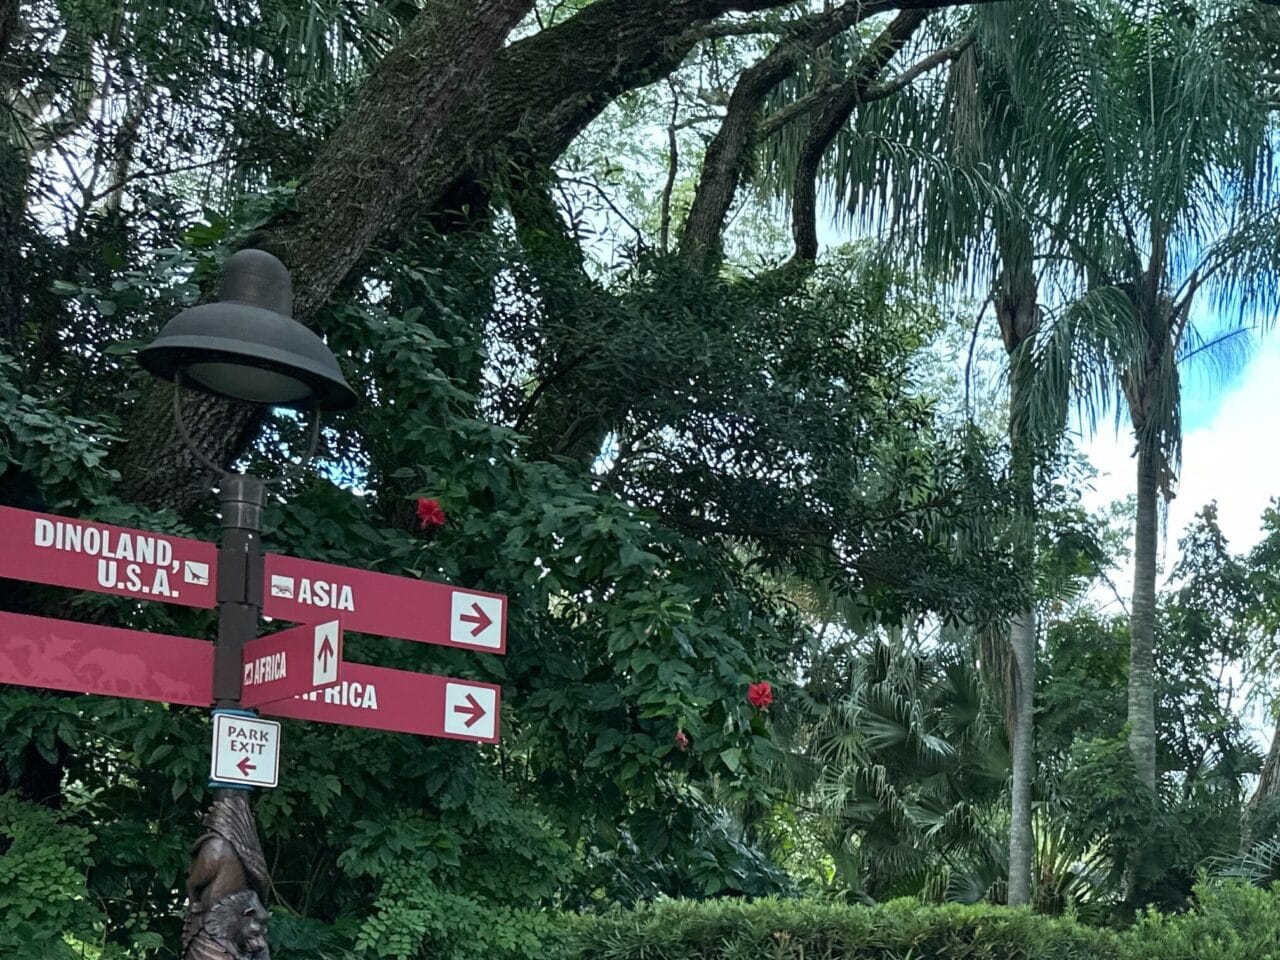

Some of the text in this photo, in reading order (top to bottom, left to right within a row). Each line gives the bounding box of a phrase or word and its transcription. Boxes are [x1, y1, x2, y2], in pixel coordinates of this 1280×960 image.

[35, 518, 180, 574] DINOLAND,
[98, 559, 180, 598] U.S.A.
[298, 578, 354, 612] ASIA
[254, 651, 287, 685] AFRICA
[227, 725, 269, 742] PARK
[230, 740, 266, 755] EXIT
